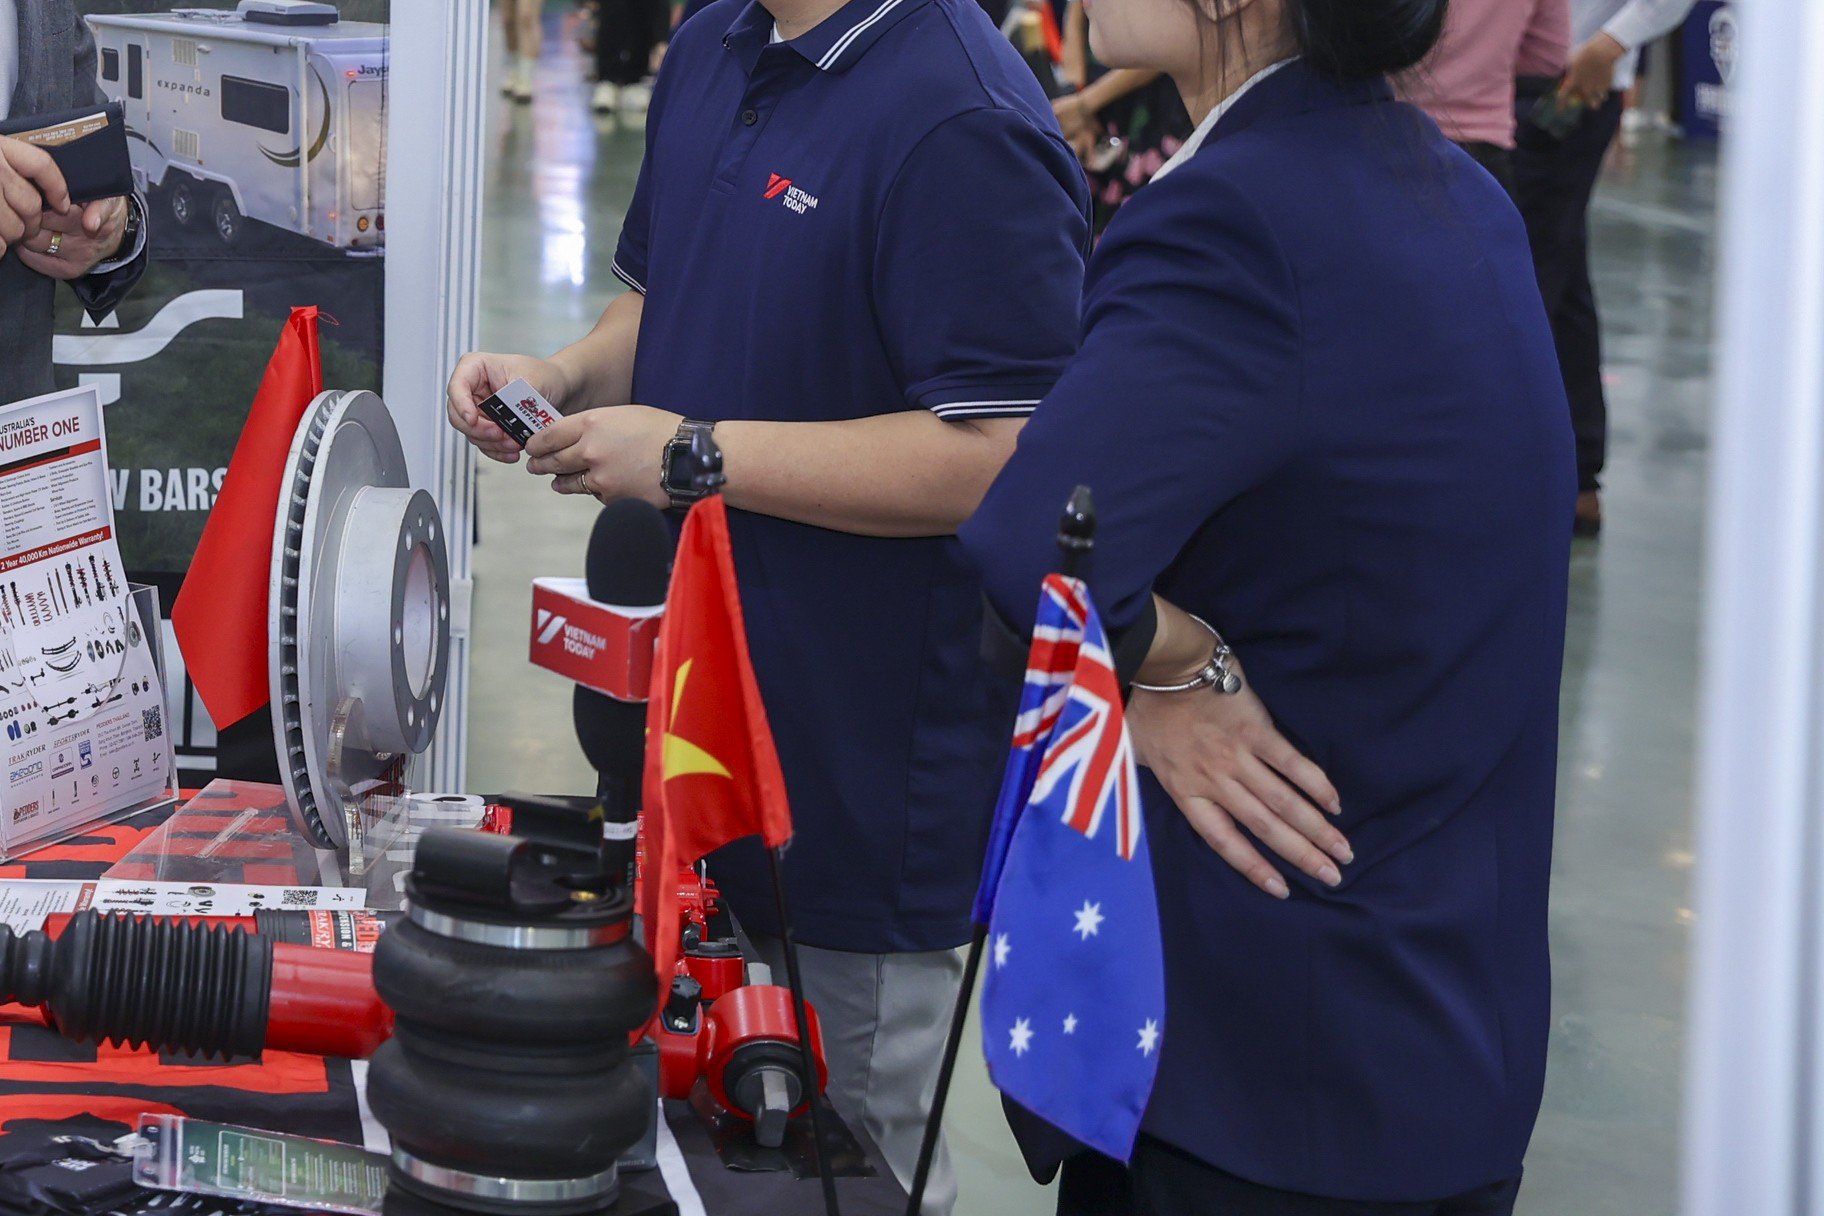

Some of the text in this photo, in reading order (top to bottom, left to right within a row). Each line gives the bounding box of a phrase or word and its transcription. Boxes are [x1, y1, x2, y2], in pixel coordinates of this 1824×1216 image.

[157, 78, 211, 98] expanda
[782, 194, 808, 215] TODAY
[787, 185, 819, 209] VIETNAM
[52, 416, 80, 437] ONE
[6, 558, 18, 569] Year
[48, 541, 78, 556] Nationwide
[78, 531, 104, 546] Warranty!
[563, 622, 607, 651] VIETNAM
[562, 637, 597, 660] TODAY
